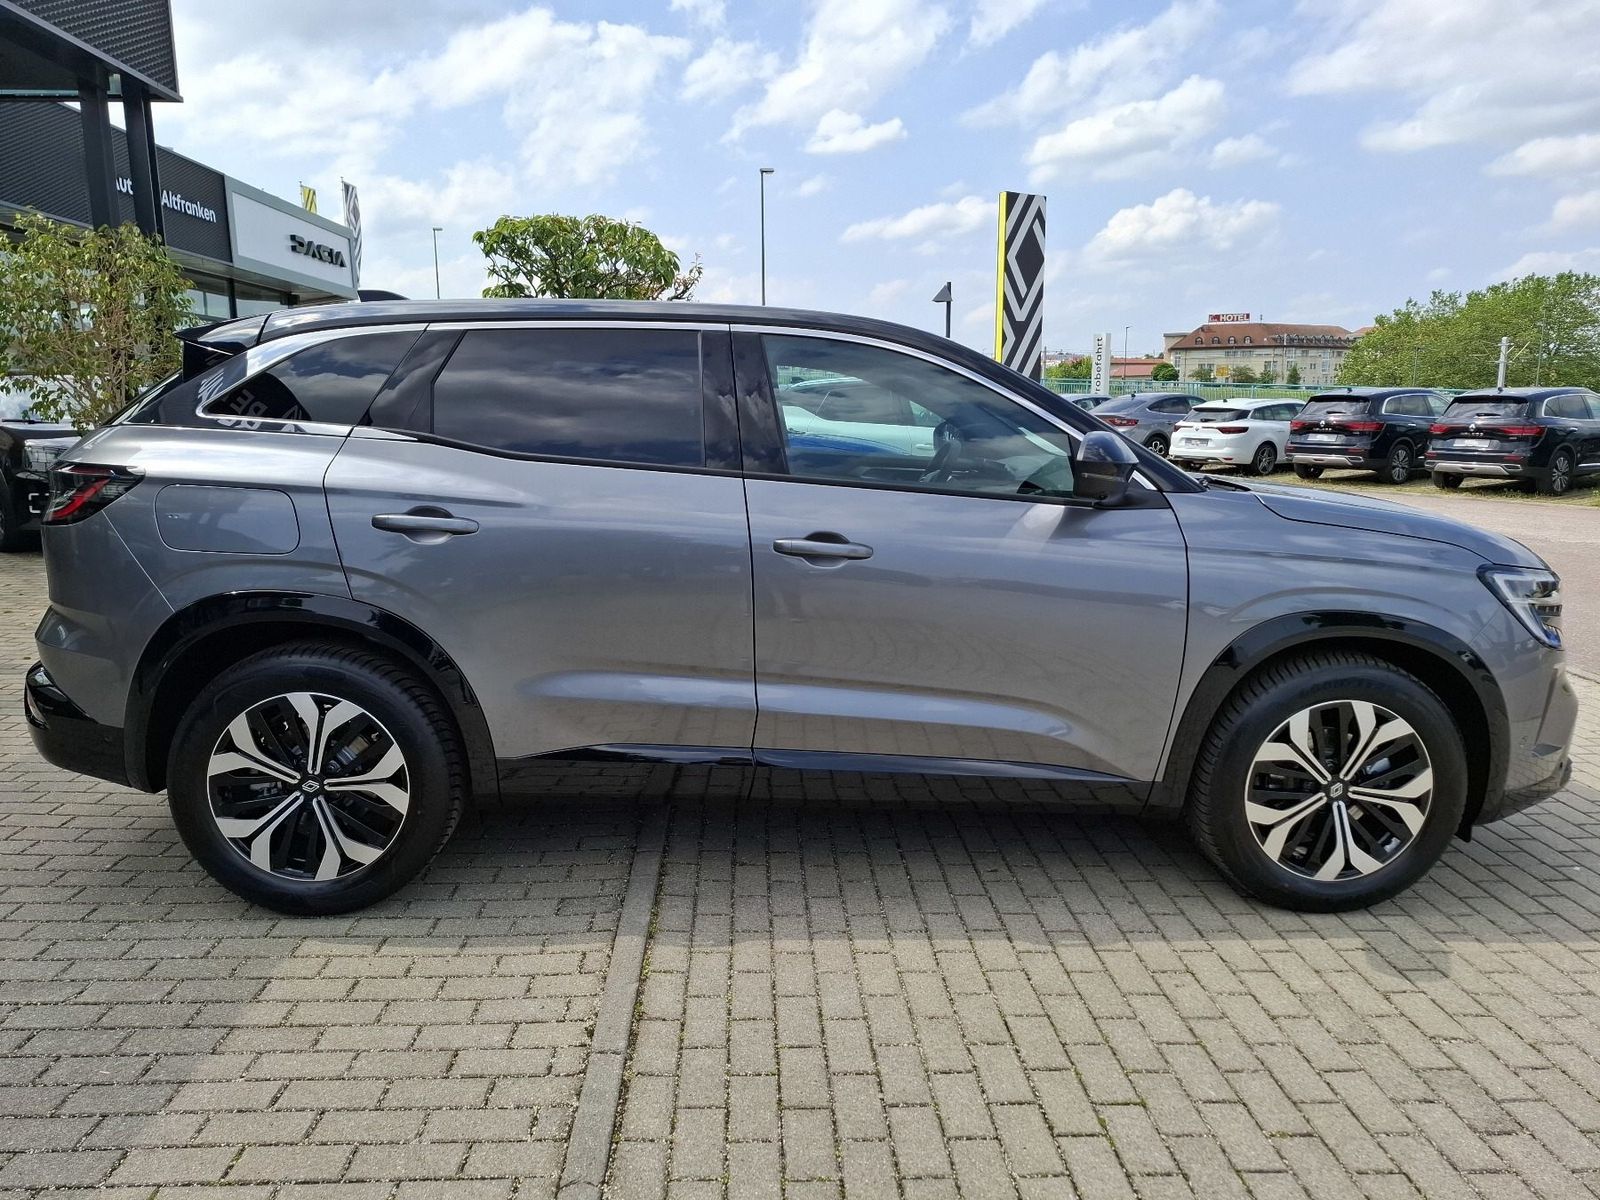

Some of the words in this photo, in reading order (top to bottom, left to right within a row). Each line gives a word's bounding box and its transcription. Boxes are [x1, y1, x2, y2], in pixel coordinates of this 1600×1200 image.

[161, 189, 217, 223] Altfranken
[289, 233, 347, 268] DACIA
[1219, 313, 1250, 322] HOTEL
